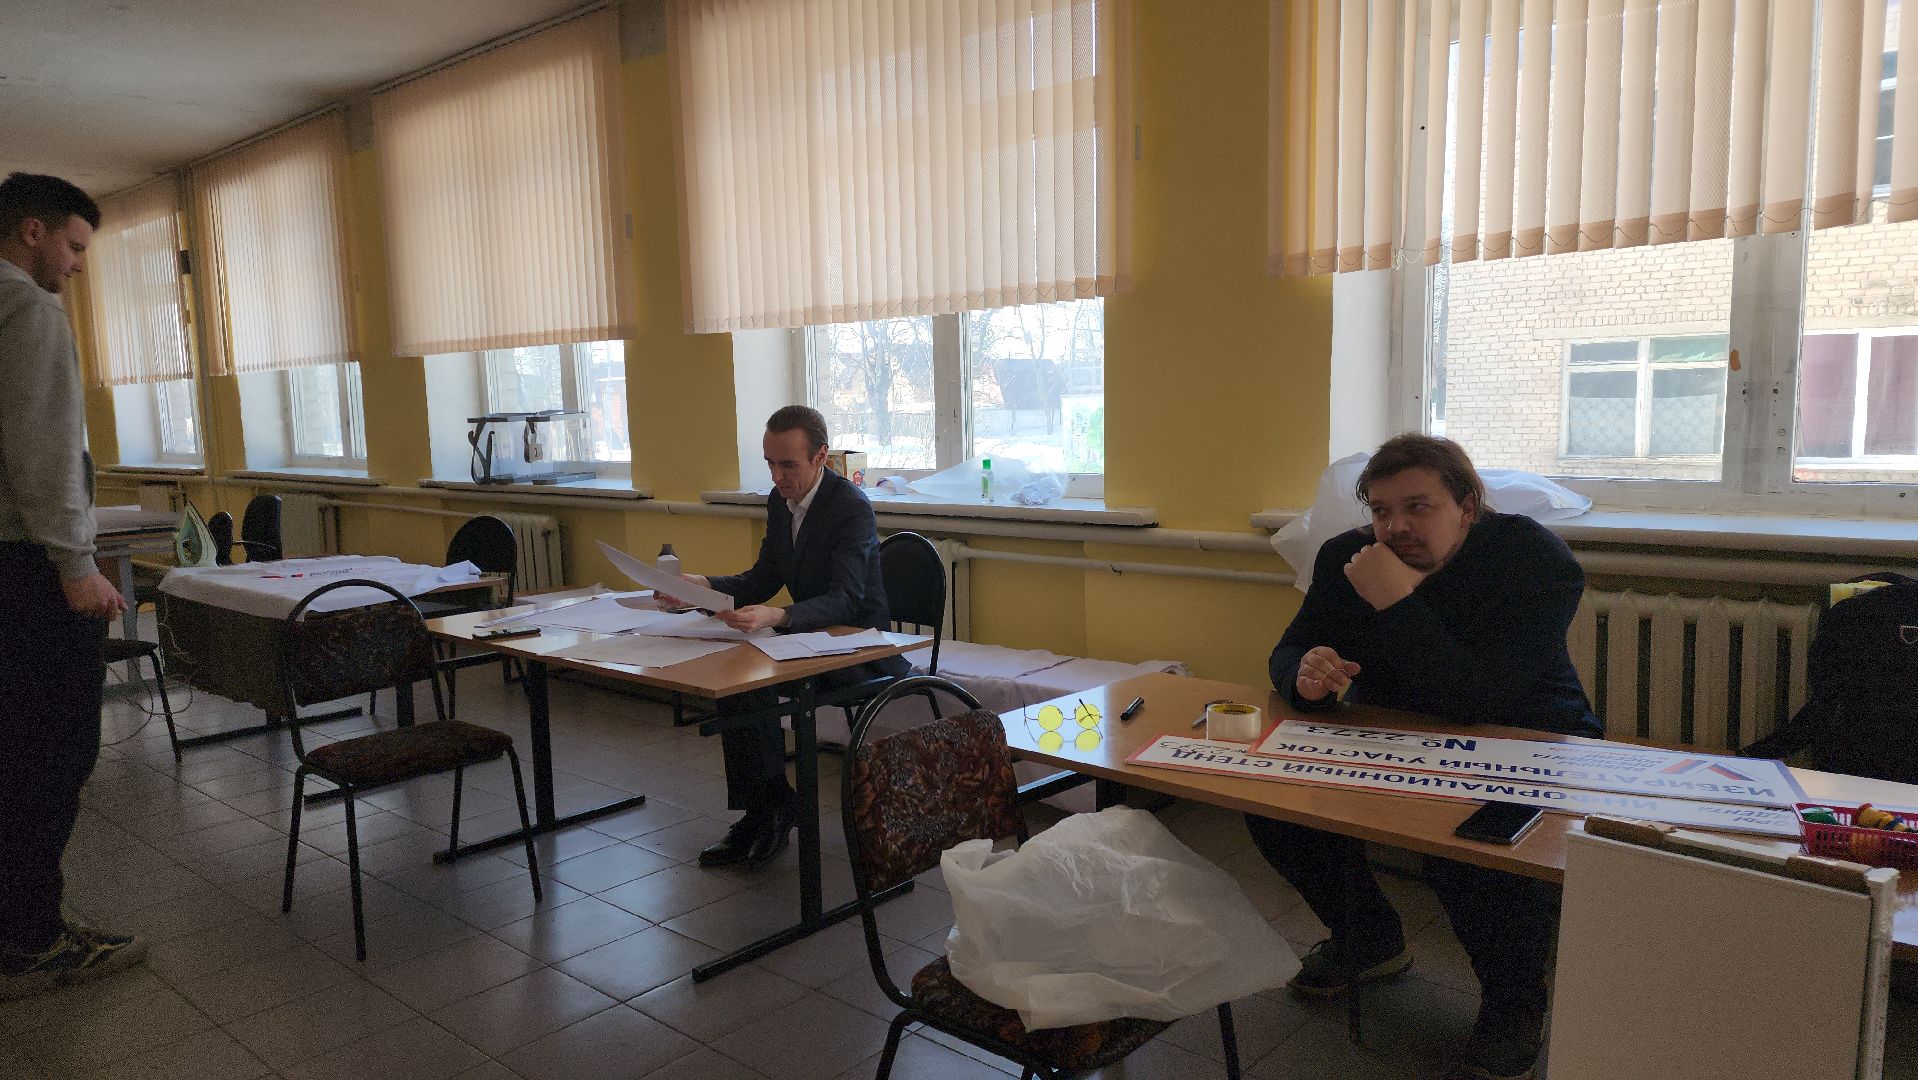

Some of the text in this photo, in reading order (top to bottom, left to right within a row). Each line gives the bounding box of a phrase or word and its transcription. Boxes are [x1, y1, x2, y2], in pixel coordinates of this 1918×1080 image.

[1307, 726, 1407, 741] 2273
[1172, 749, 1657, 810] ИНФОРМАЦИОННЫЙ СТЕНД
[1276, 743, 1776, 797] ИЗБИРАТЕЛЬНЫЙ УЧАСТОК
